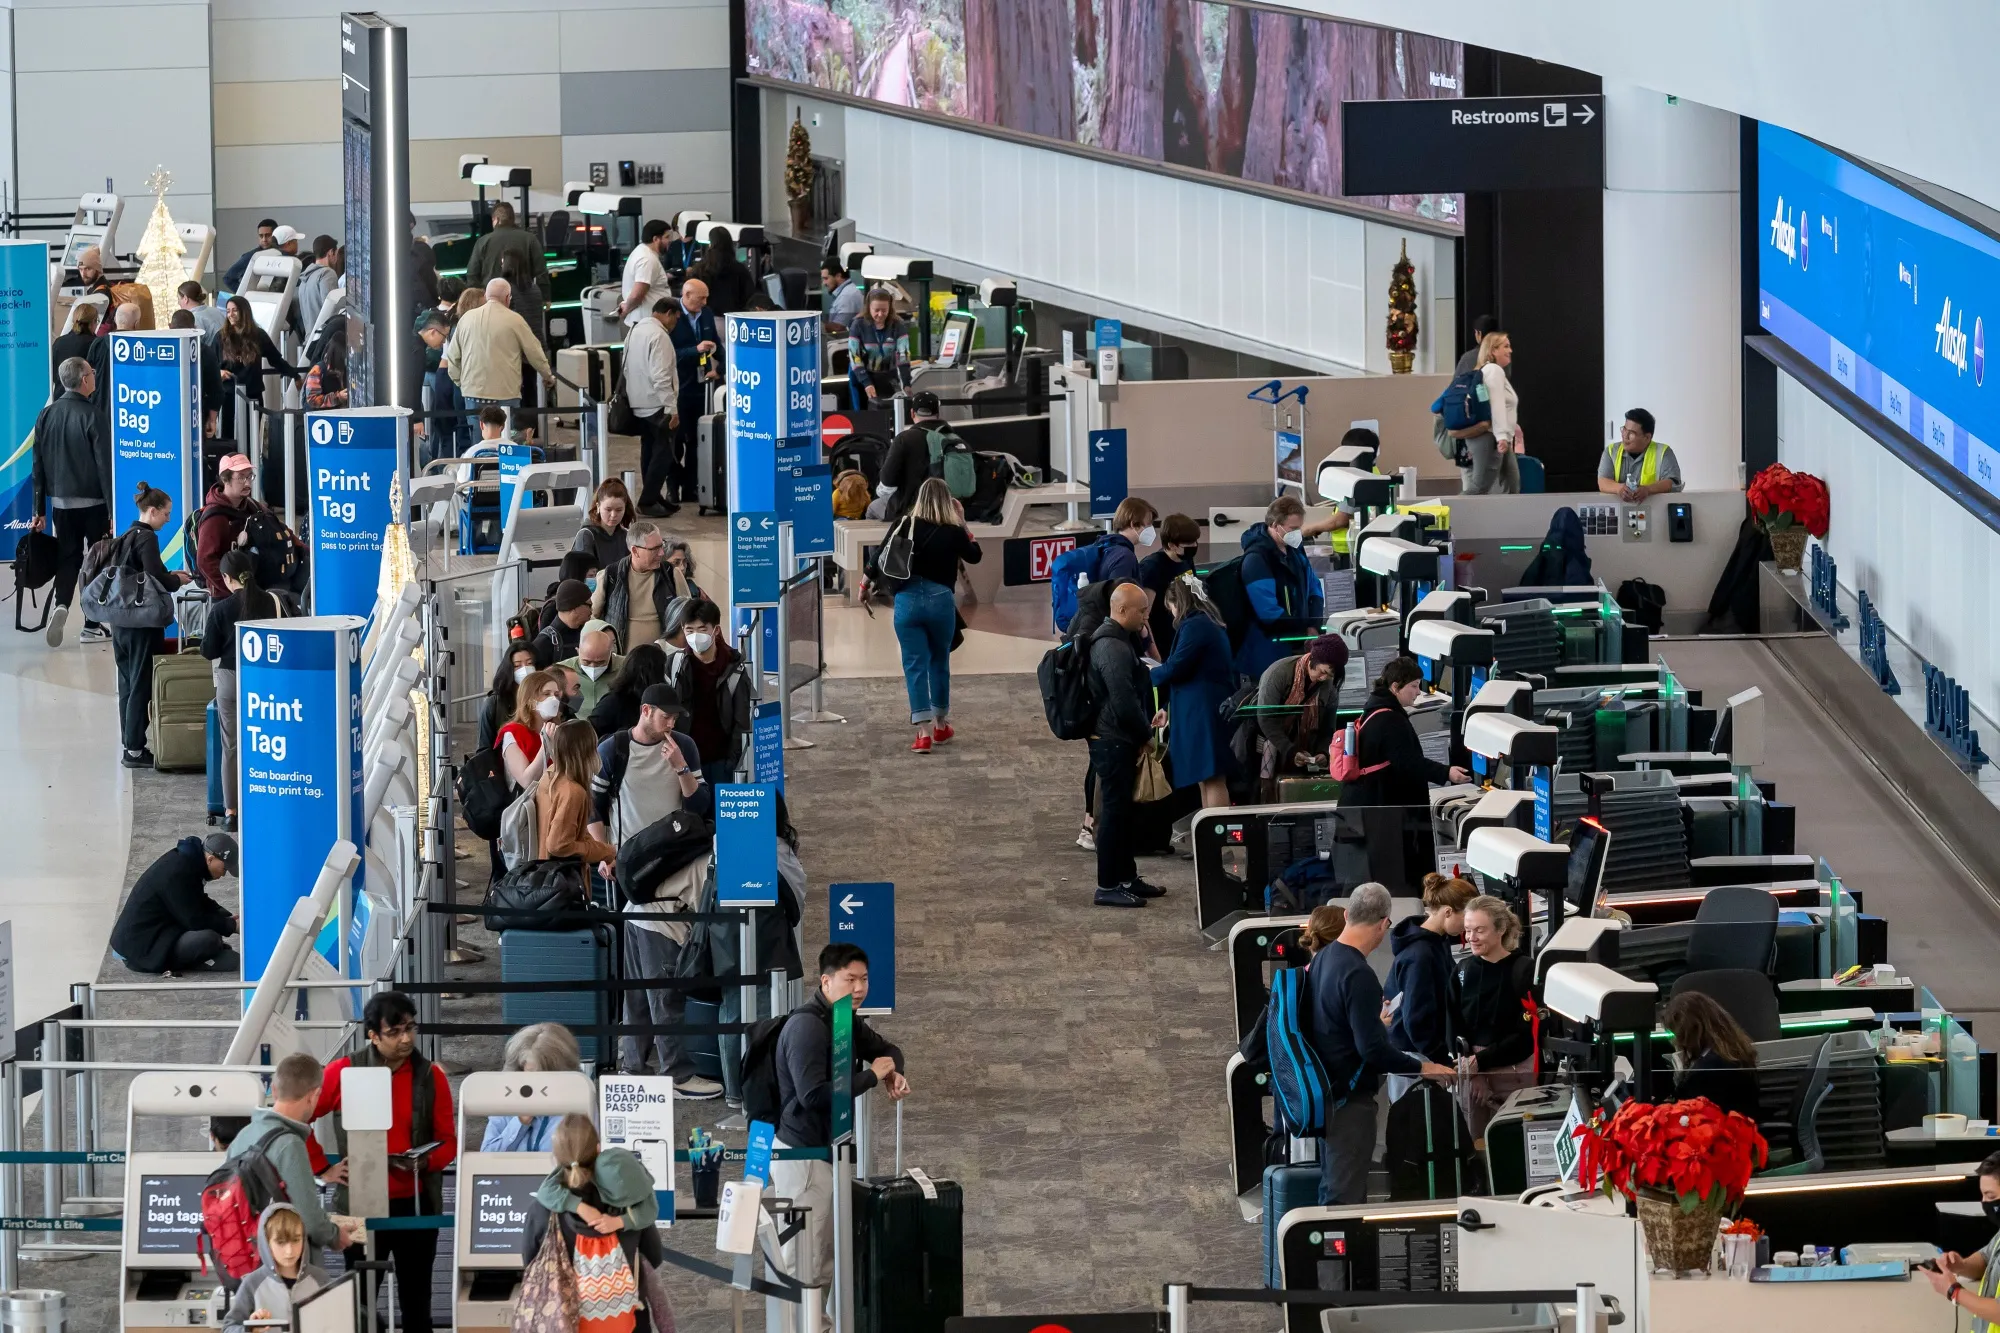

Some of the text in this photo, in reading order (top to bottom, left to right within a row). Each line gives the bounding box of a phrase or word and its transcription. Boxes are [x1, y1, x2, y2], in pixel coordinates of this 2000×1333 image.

[1452, 110, 1539, 124] Restrooms
[0, 288, 23, 296] exico
[0, 300, 30, 309] eck-In
[730, 363, 760, 389] Drop
[791, 366, 816, 387] Drop
[118, 384, 161, 409] Drop
[730, 388, 751, 414] Bag
[791, 391, 813, 412] Bag
[119, 408, 150, 434] Bag
[755, 431, 772, 440] ready.
[120, 439, 133, 447] Have
[120, 450, 176, 460] tagged bag ready.
[502, 463, 515, 471] Drop
[319, 468, 370, 491] Print
[318, 496, 356, 523] Tag
[4, 519, 33, 529] Alask
[321, 529, 378, 540] Scan boarding
[349, 543, 368, 551] print
[248, 692, 303, 722] Print
[247, 726, 286, 761] Tag
[352, 727, 362, 753] Ta
[249, 768, 312, 784] Scan boarding
[250, 784, 324, 798] pass to print tag.
[720, 789, 754, 797] Proceed
[720, 810, 759, 819] bag drop
[606, 1084, 645, 1093] NEED A
[606, 1094, 666, 1103] BOARDING
[606, 1103, 639, 1112] PASS?
[87, 1154, 126, 1162] First Cla
[149, 1194, 181, 1206] Print
[481, 1194, 512, 1206] Print
[148, 1209, 173, 1224] bag
[480, 1209, 527, 1224] bag ta
[2, 1220, 24, 1228] First
[26, 1220, 52, 1229] Class
[64, 1221, 84, 1229] Elite
